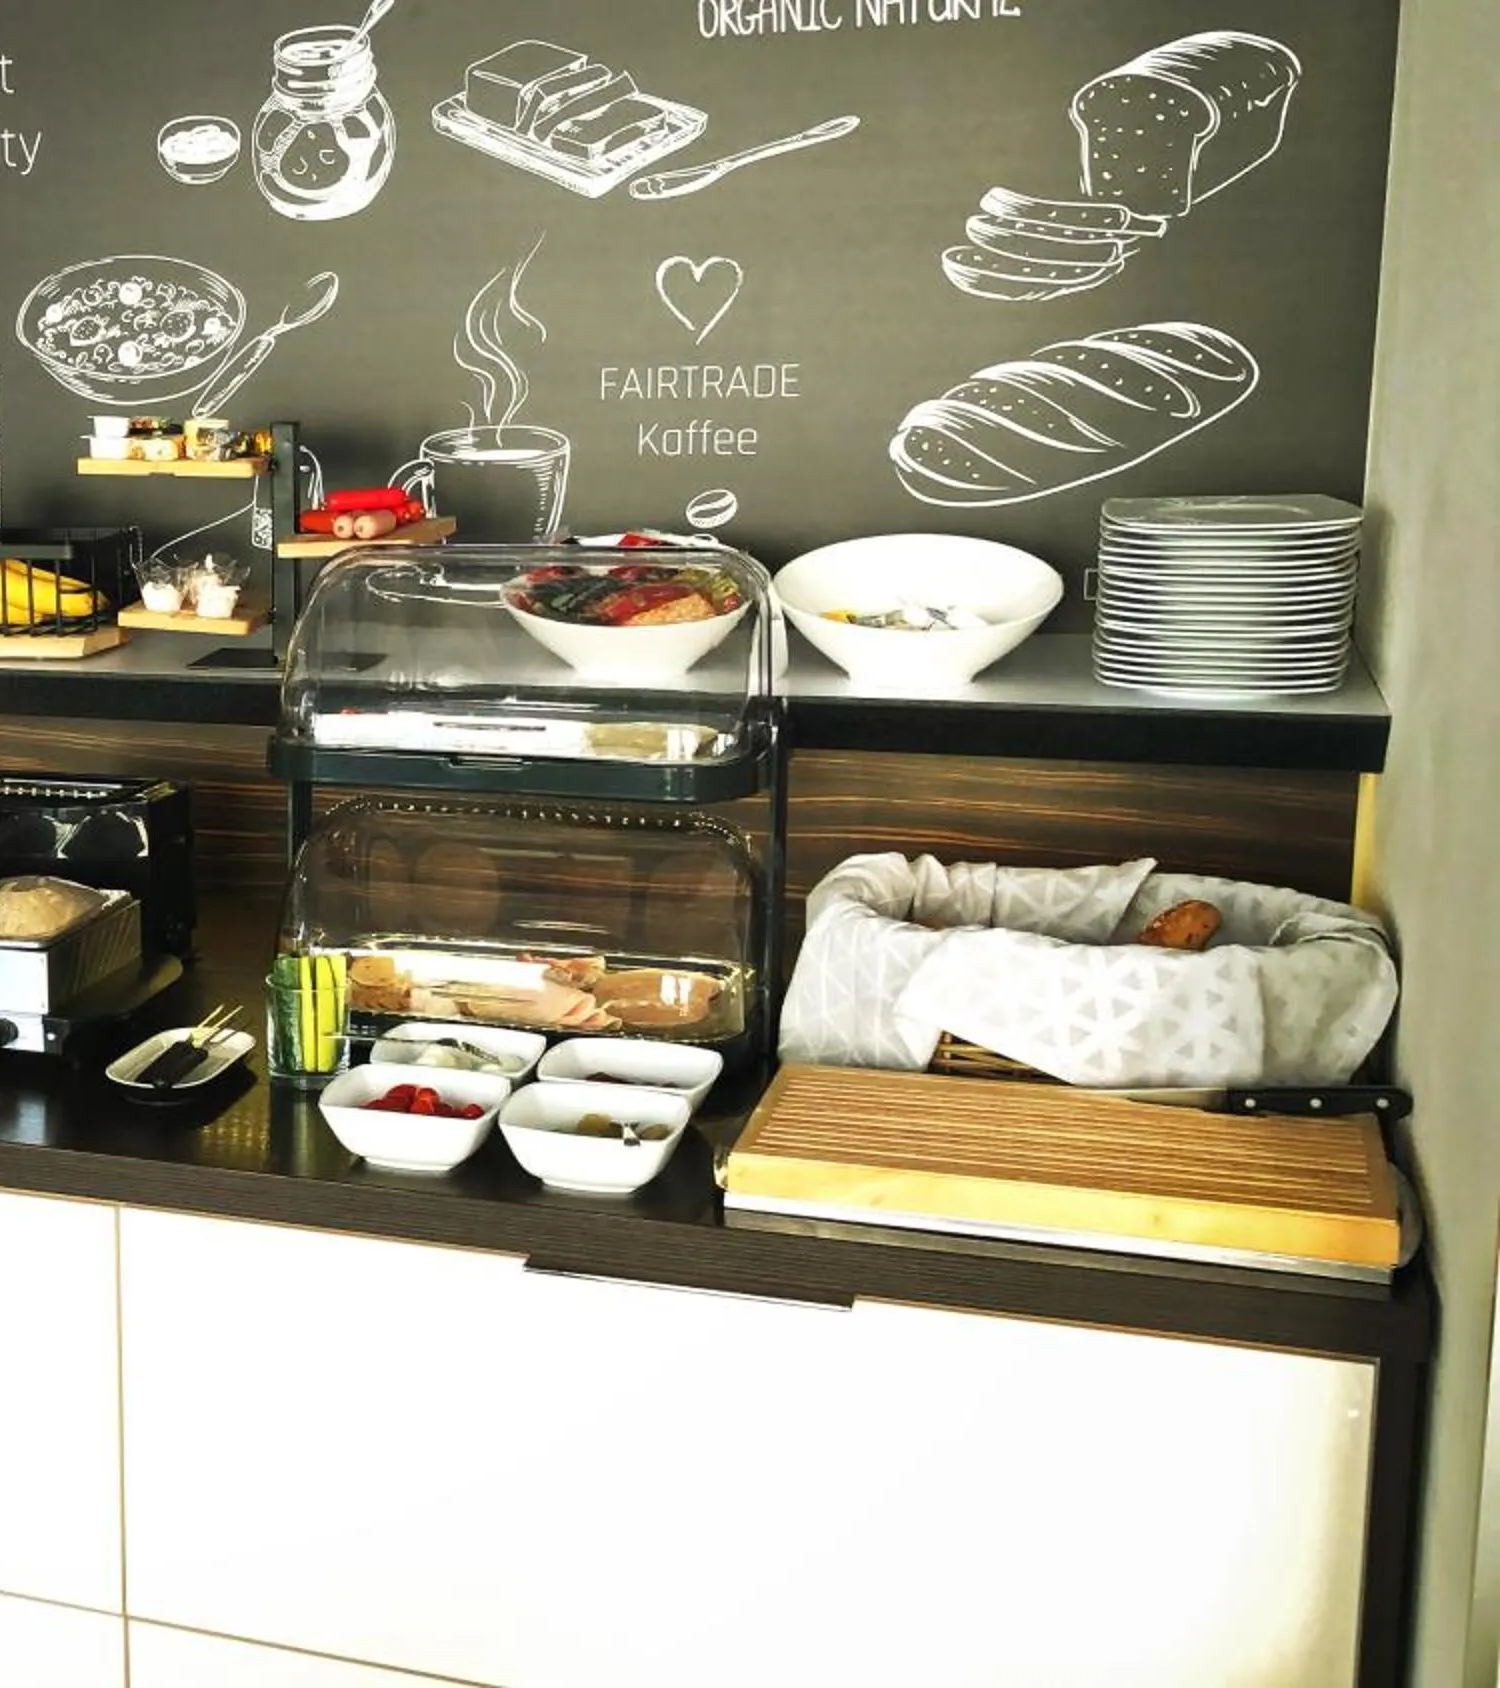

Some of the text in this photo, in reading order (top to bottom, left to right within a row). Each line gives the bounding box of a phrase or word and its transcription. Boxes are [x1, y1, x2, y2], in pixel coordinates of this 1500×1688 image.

[698, 0, 843, 38] ORGANIC
[600, 363, 800, 401] FAIRTRADE
[637, 419, 758, 456] Kaffee
